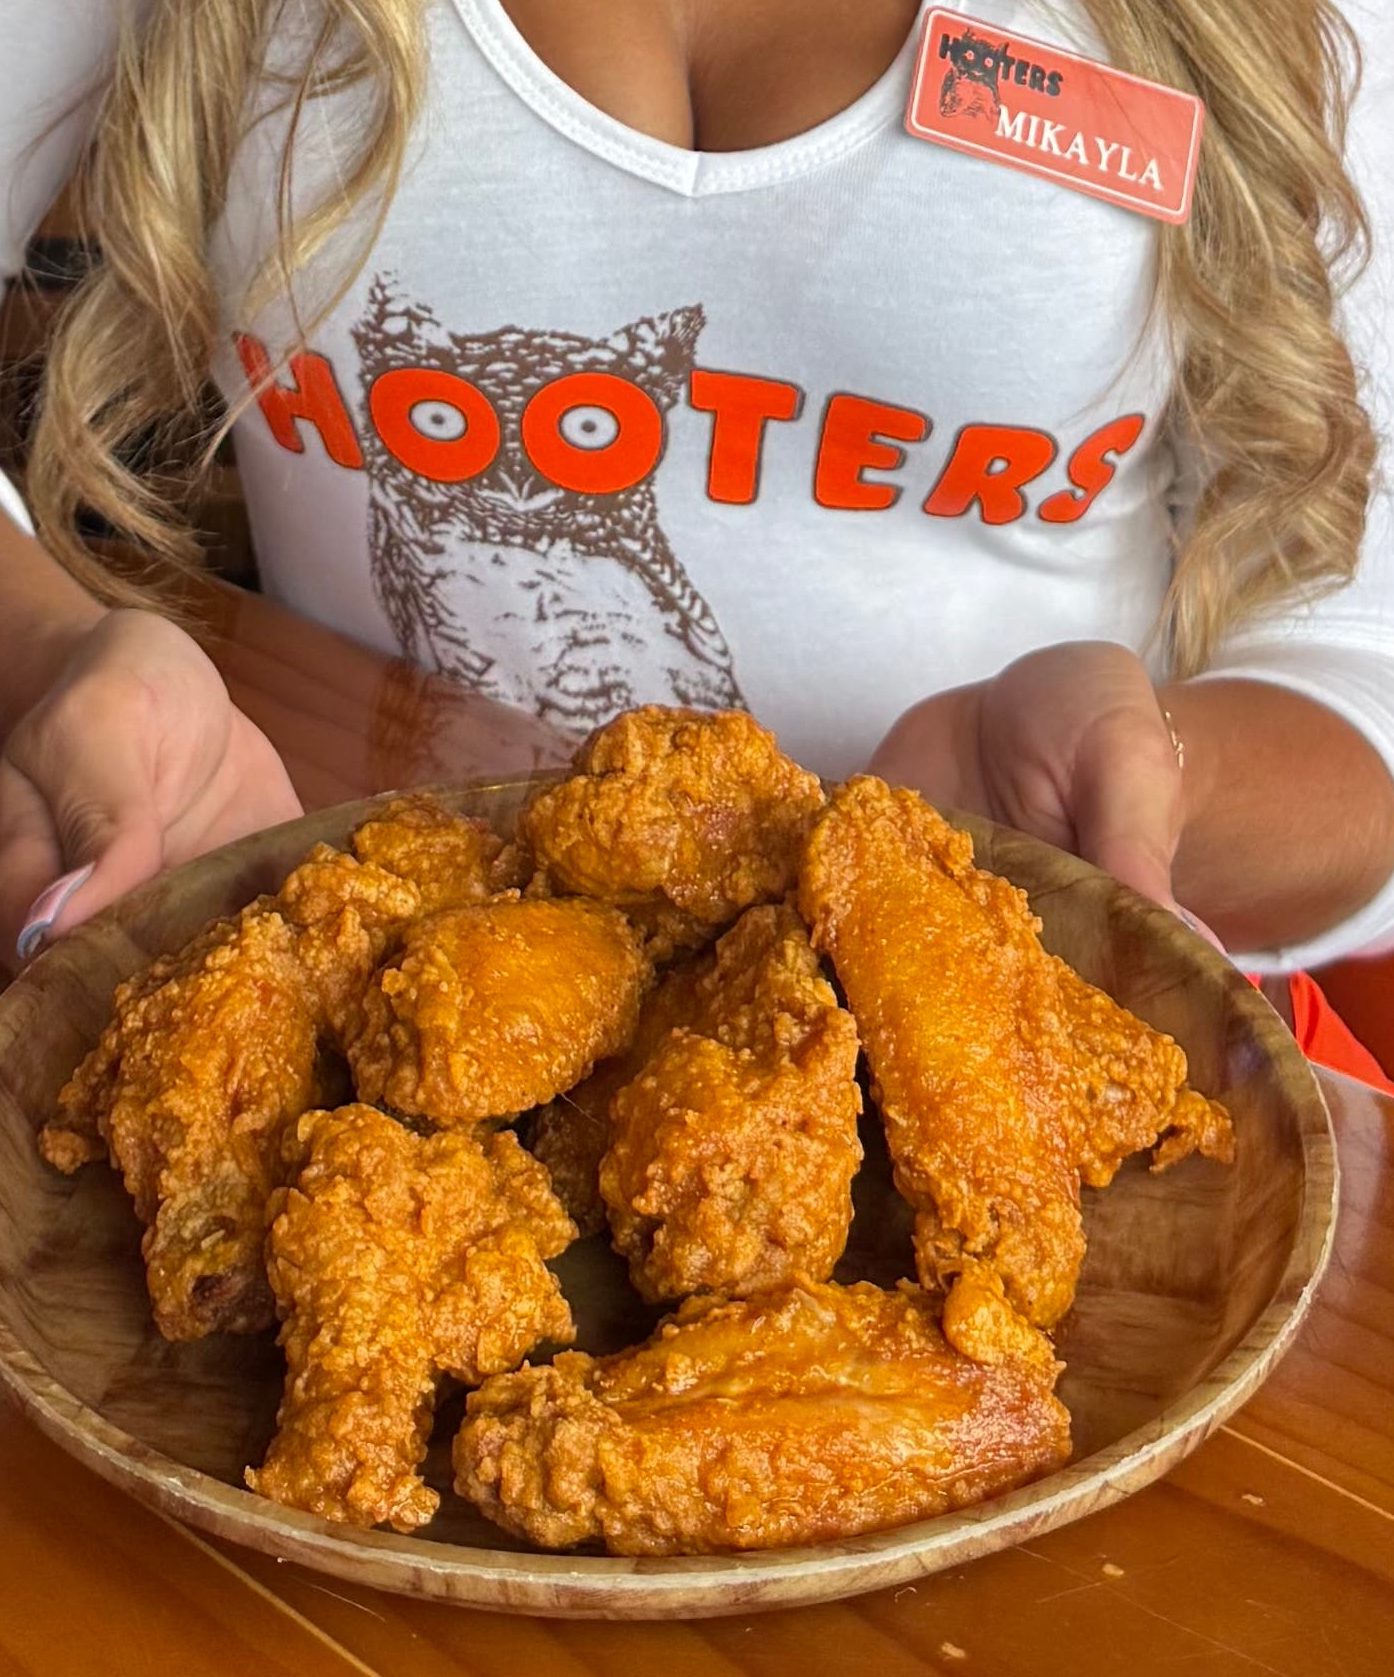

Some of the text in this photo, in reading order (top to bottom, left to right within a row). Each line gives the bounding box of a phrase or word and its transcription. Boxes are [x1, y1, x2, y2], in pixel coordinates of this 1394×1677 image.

[938, 32, 1065, 97] HOOTERS
[995, 104, 1164, 190] MIKAYLA
[232, 331, 1146, 525] HOOTERS
